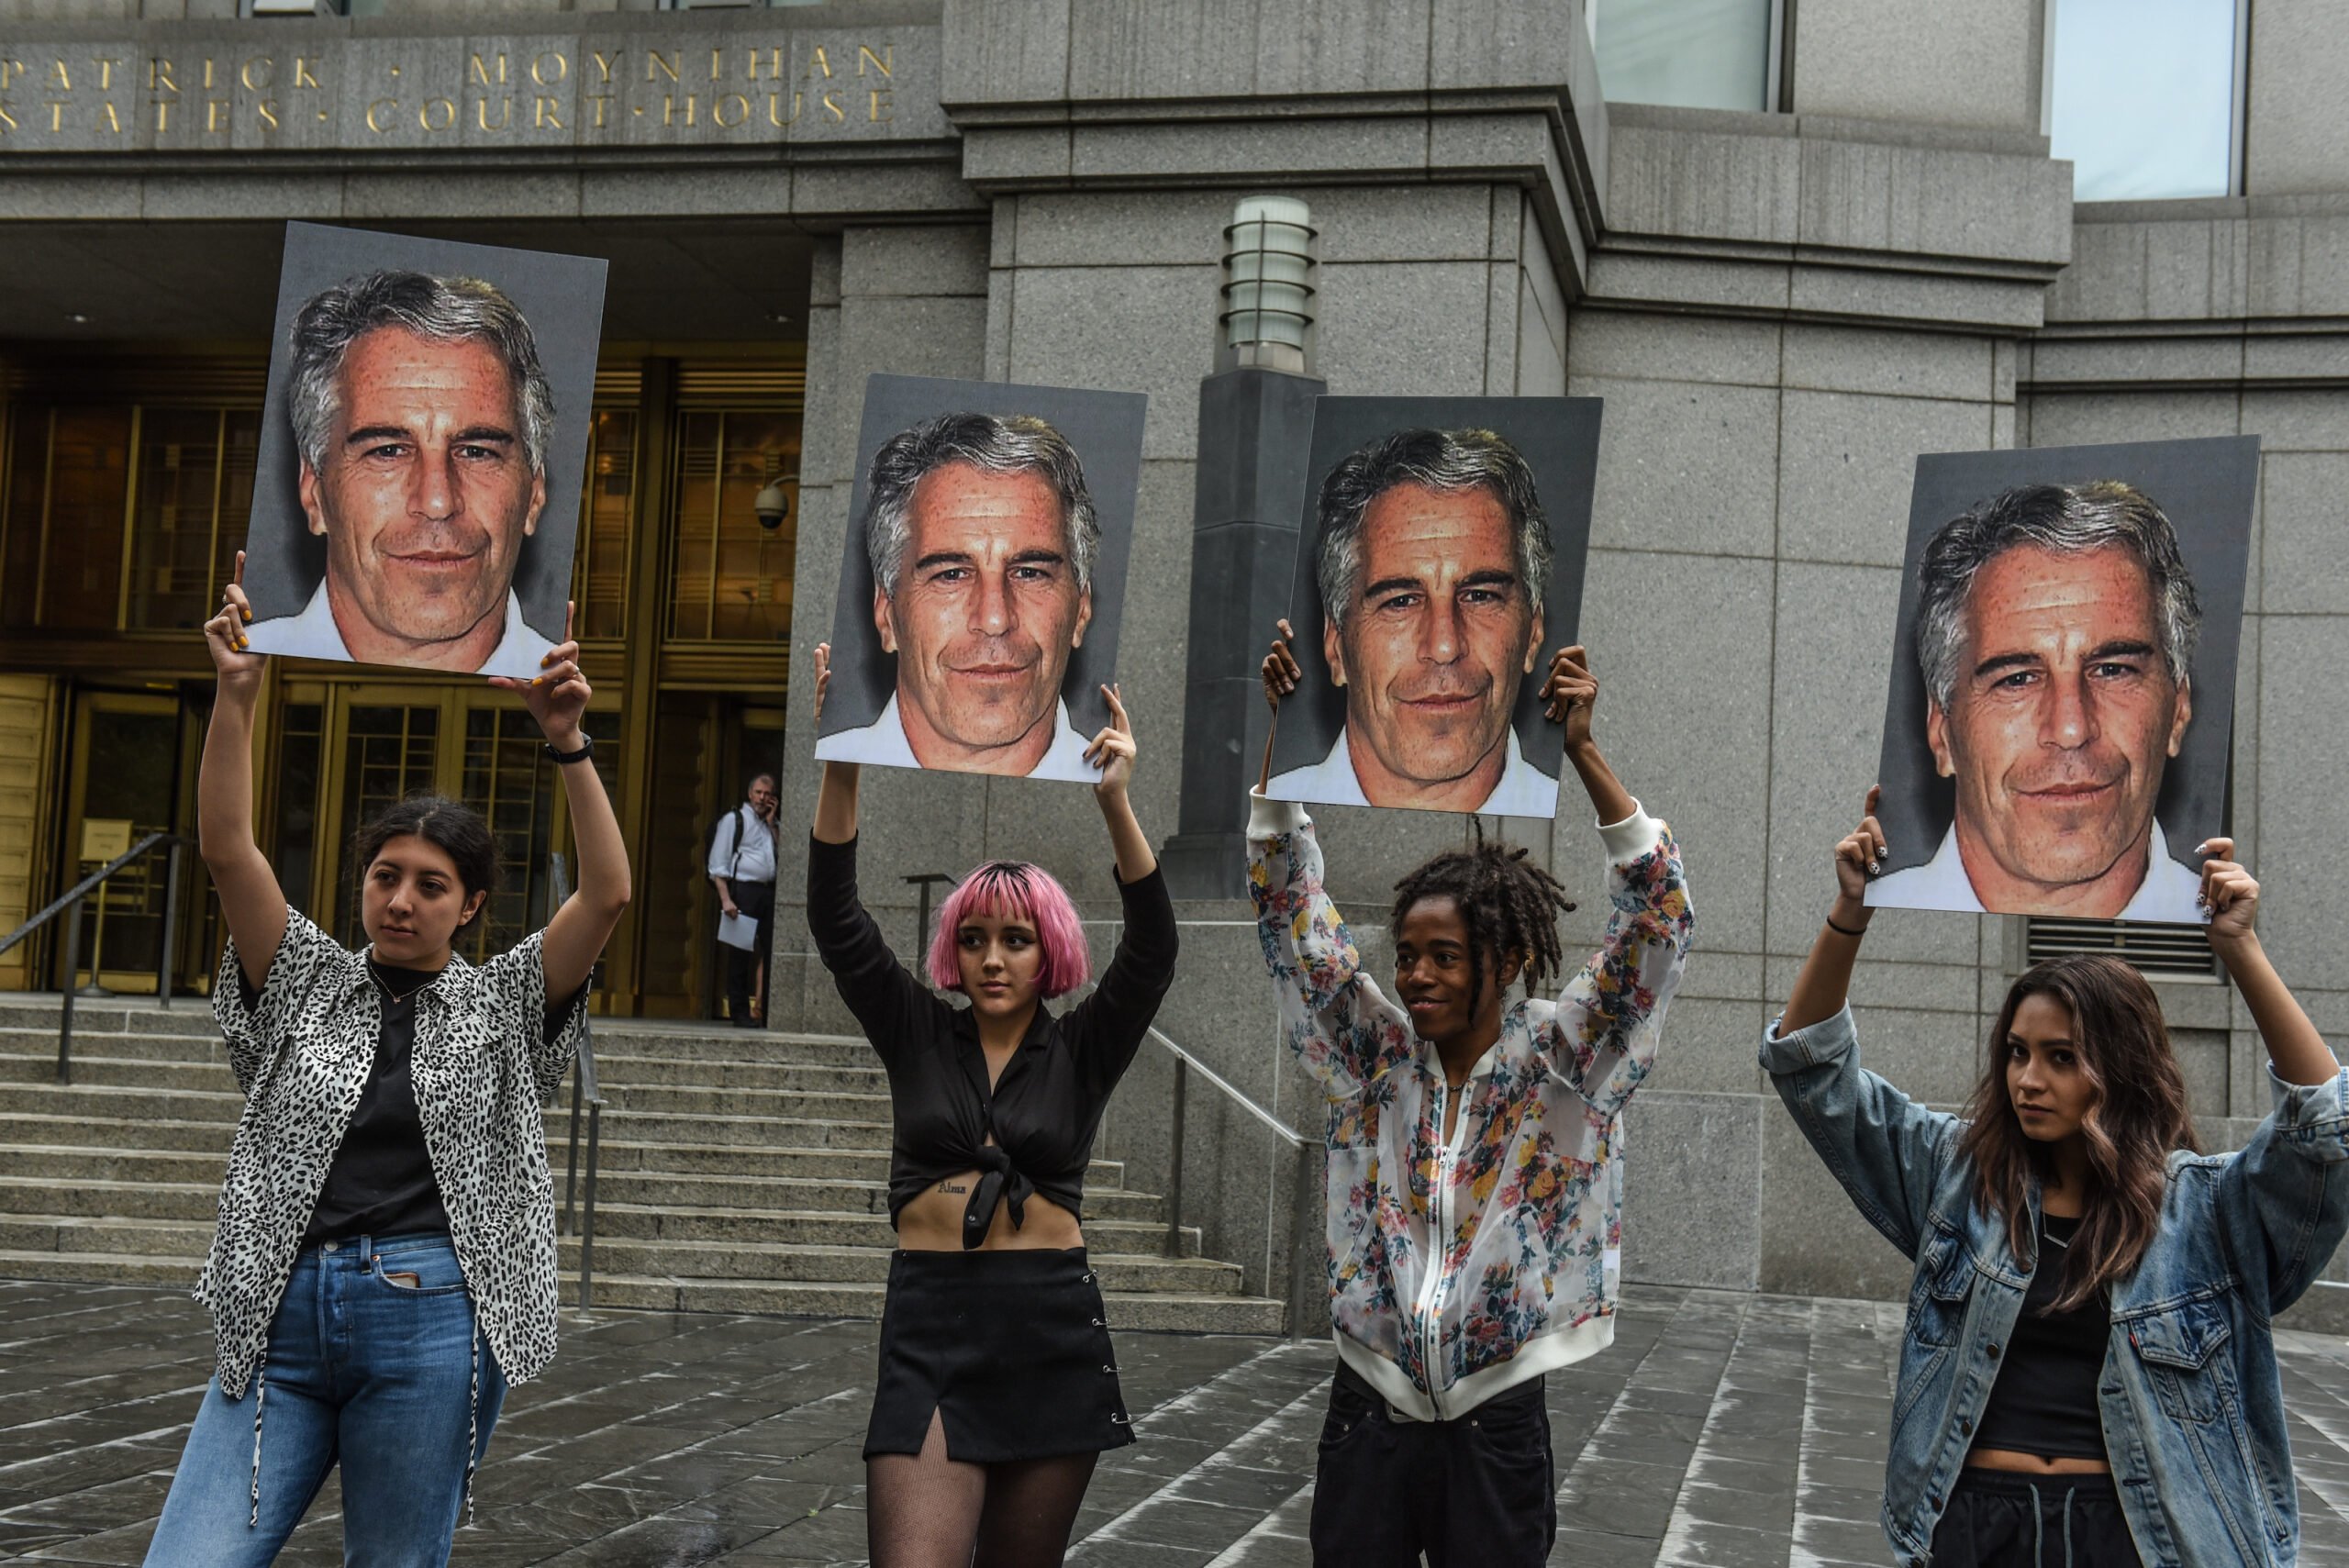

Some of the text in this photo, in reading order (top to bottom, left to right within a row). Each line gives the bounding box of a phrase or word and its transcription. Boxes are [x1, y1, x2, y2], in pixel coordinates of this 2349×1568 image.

[1, 43, 895, 91] PATRICK MOYNIHAN
[0, 98, 278, 134] STATES
